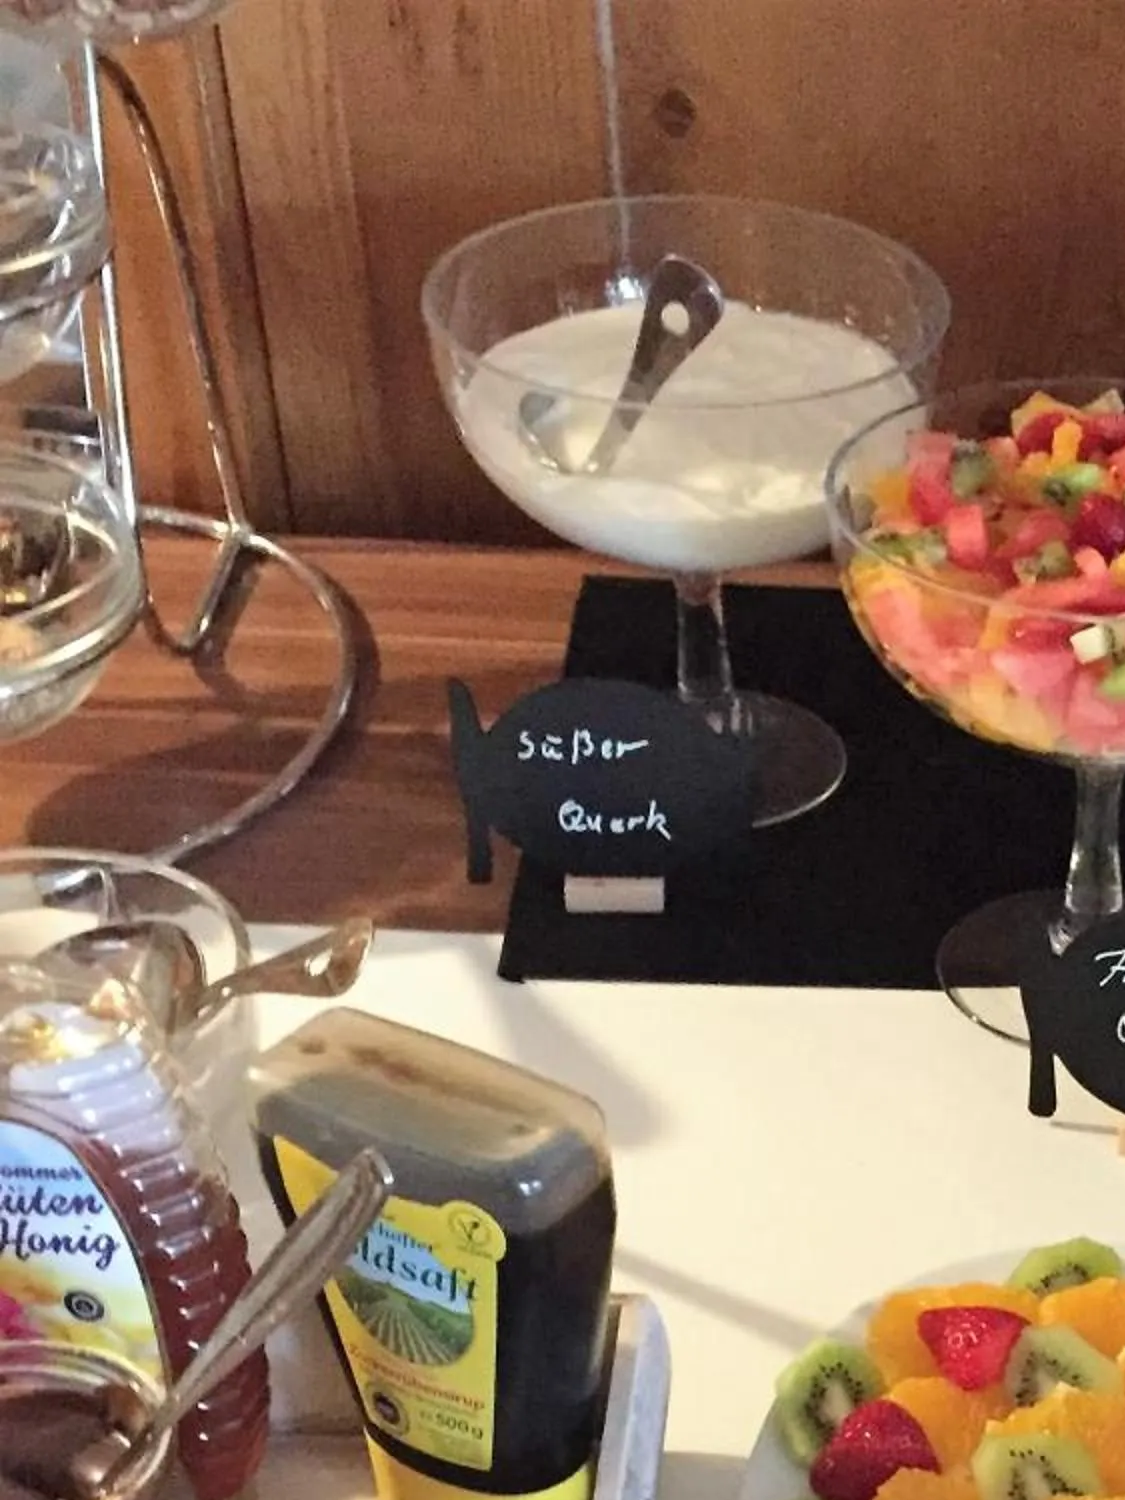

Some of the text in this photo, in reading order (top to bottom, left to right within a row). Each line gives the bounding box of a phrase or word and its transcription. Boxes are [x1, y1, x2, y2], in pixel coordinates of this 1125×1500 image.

[557, 799, 673, 841] Quark
[0, 1165, 83, 1181] ommer
[0, 1183, 104, 1217] üten
[354, 1234, 478, 1302] ldsaft
